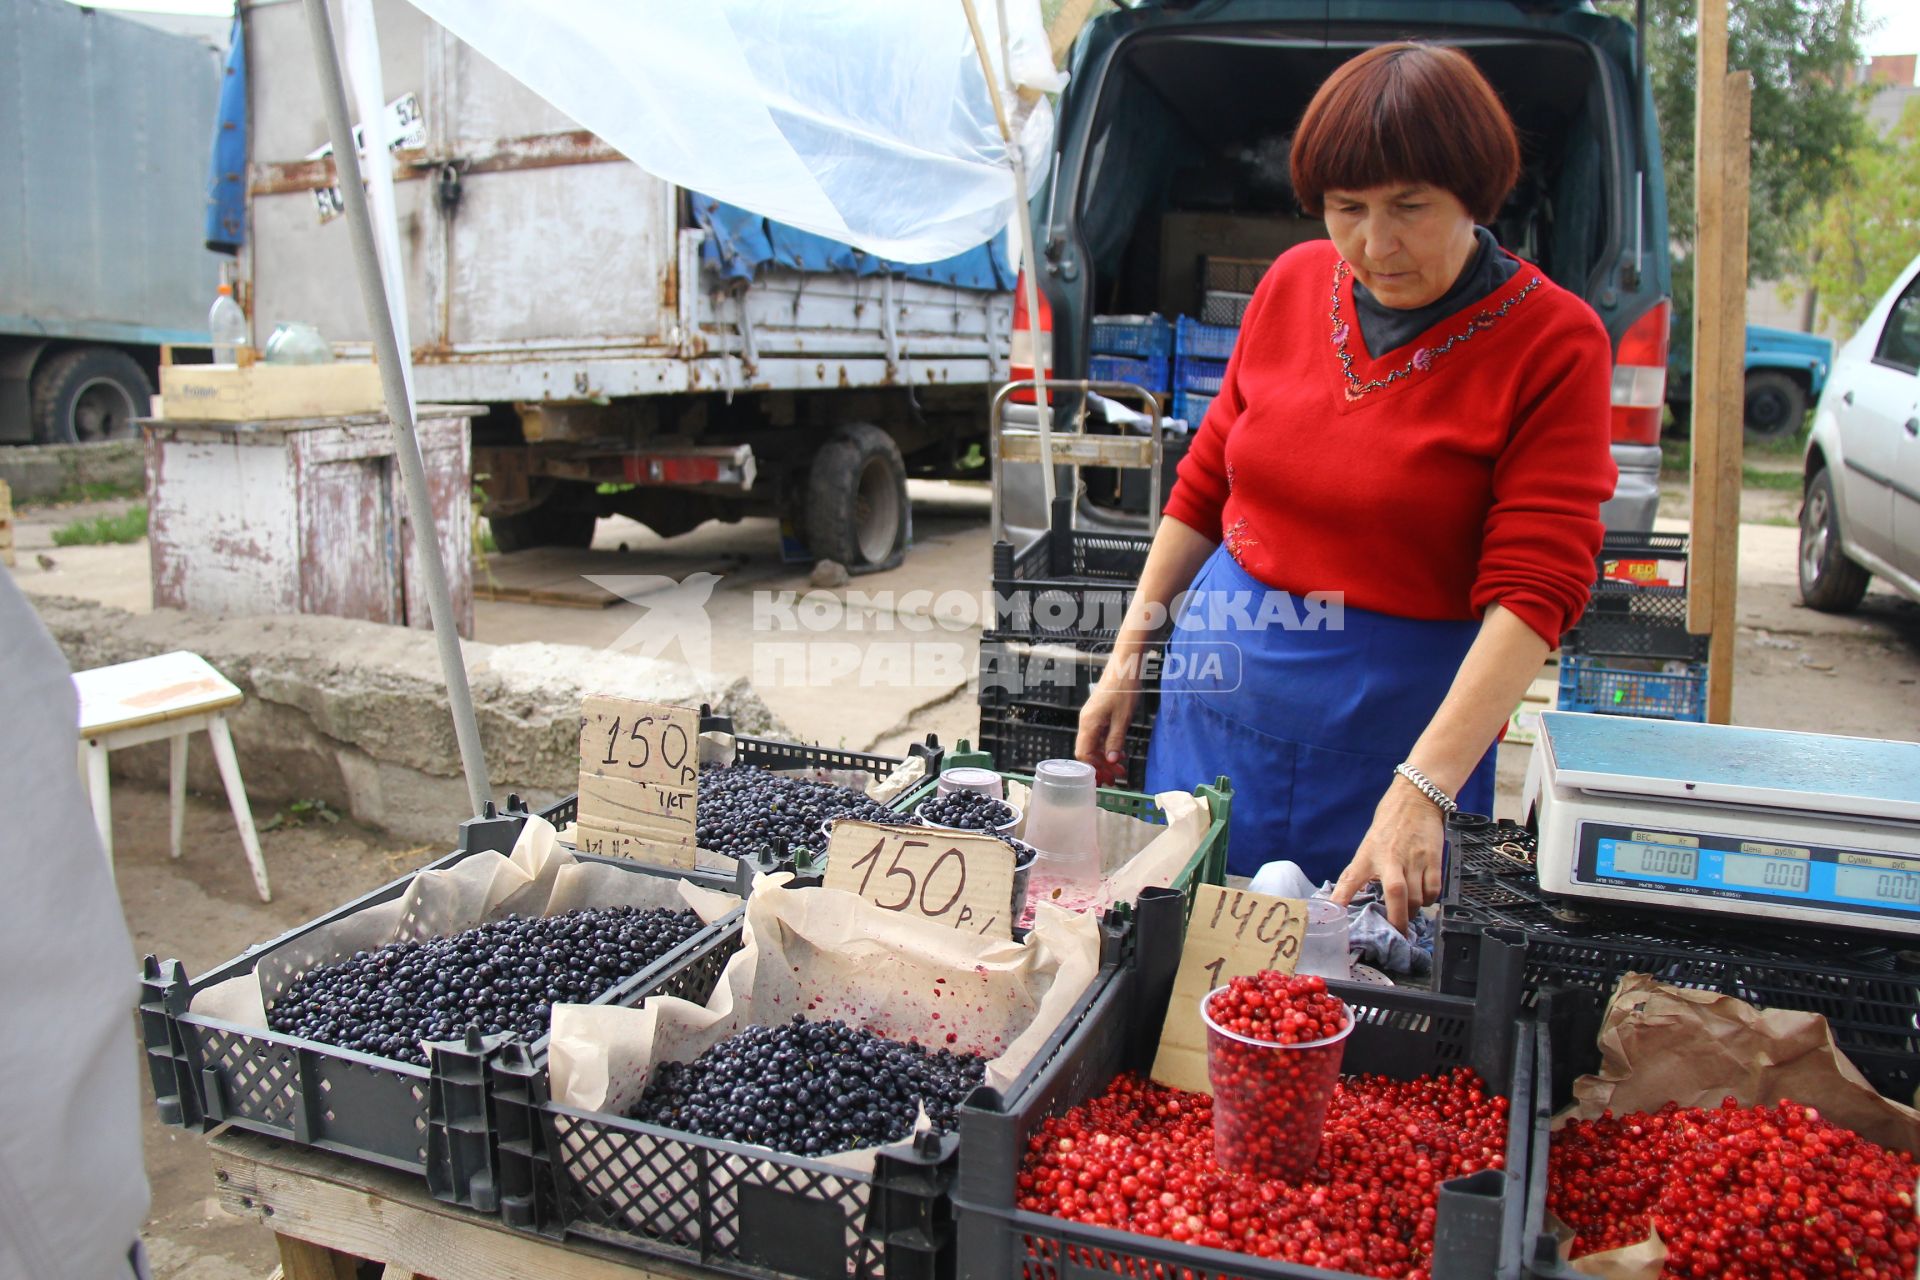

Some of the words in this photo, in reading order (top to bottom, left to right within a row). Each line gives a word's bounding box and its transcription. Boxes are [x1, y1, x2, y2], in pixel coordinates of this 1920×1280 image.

[397, 98, 418, 126] 52
[602, 716, 687, 769] 150
[1636, 833, 1651, 842] ВЕС
[1743, 844, 1762, 854] Цена
[1641, 848, 1693, 875] 0.000
[1764, 862, 1804, 887] 0.00
[1848, 855, 1872, 865] Сумма
[1891, 861, 1906, 870] руб
[852, 837, 966, 916] 150
[1211, 891, 1299, 943] 140
